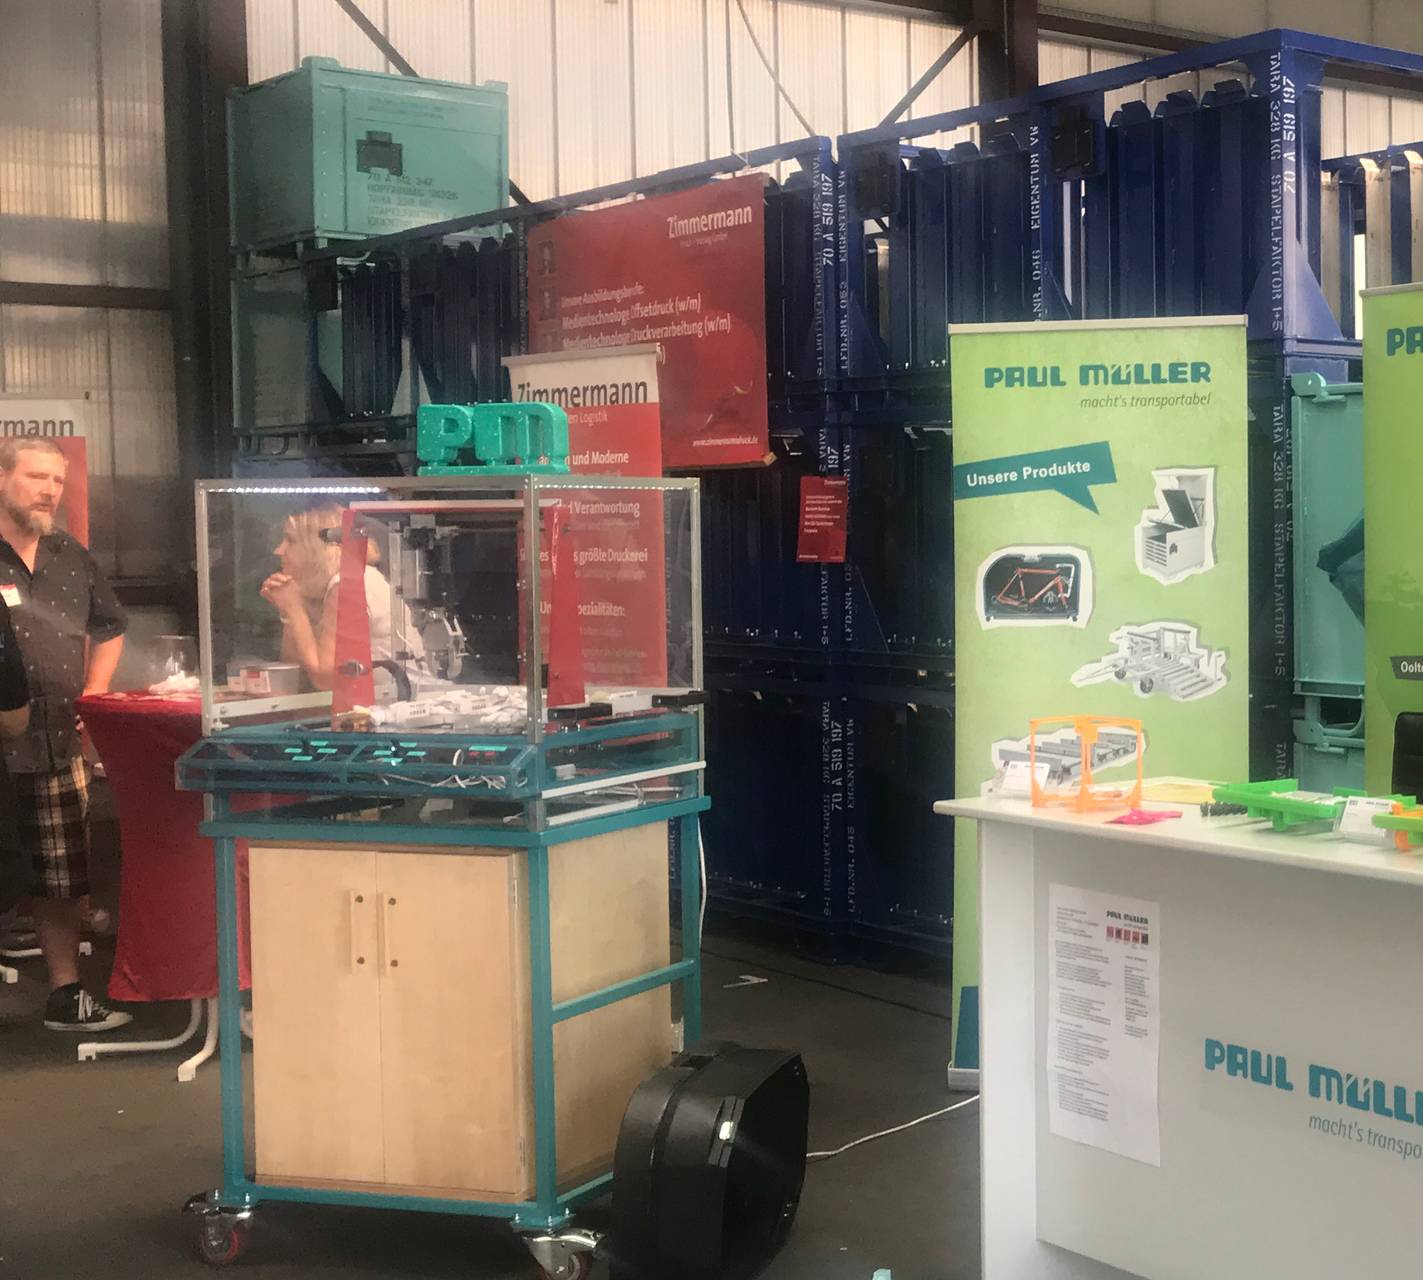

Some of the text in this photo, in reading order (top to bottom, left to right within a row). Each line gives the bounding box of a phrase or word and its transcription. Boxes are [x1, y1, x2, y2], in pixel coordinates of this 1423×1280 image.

[1282, 76, 1296, 104] 197
[1283, 113, 1296, 142] 519
[821, 172, 833, 196] 197
[1029, 153, 1041, 230] EIGENTUM
[1283, 171, 1296, 193] 70
[666, 205, 753, 239] Zimmermann
[822, 202, 834, 226] 519
[822, 247, 835, 266] 70
[984, 361, 1212, 389] PAUL MÜLLER
[1080, 392, 1211, 410] macht's transportabel
[572, 450, 590, 466] und
[591, 449, 630, 465] Moderne
[966, 459, 1091, 488] Unsere Produkte
[573, 501, 640, 518] Verantwortung
[607, 547, 648, 563] Druckerei
[1204, 1038, 1294, 1091] PAUL
[1308, 1114, 1364, 1142] macht's
